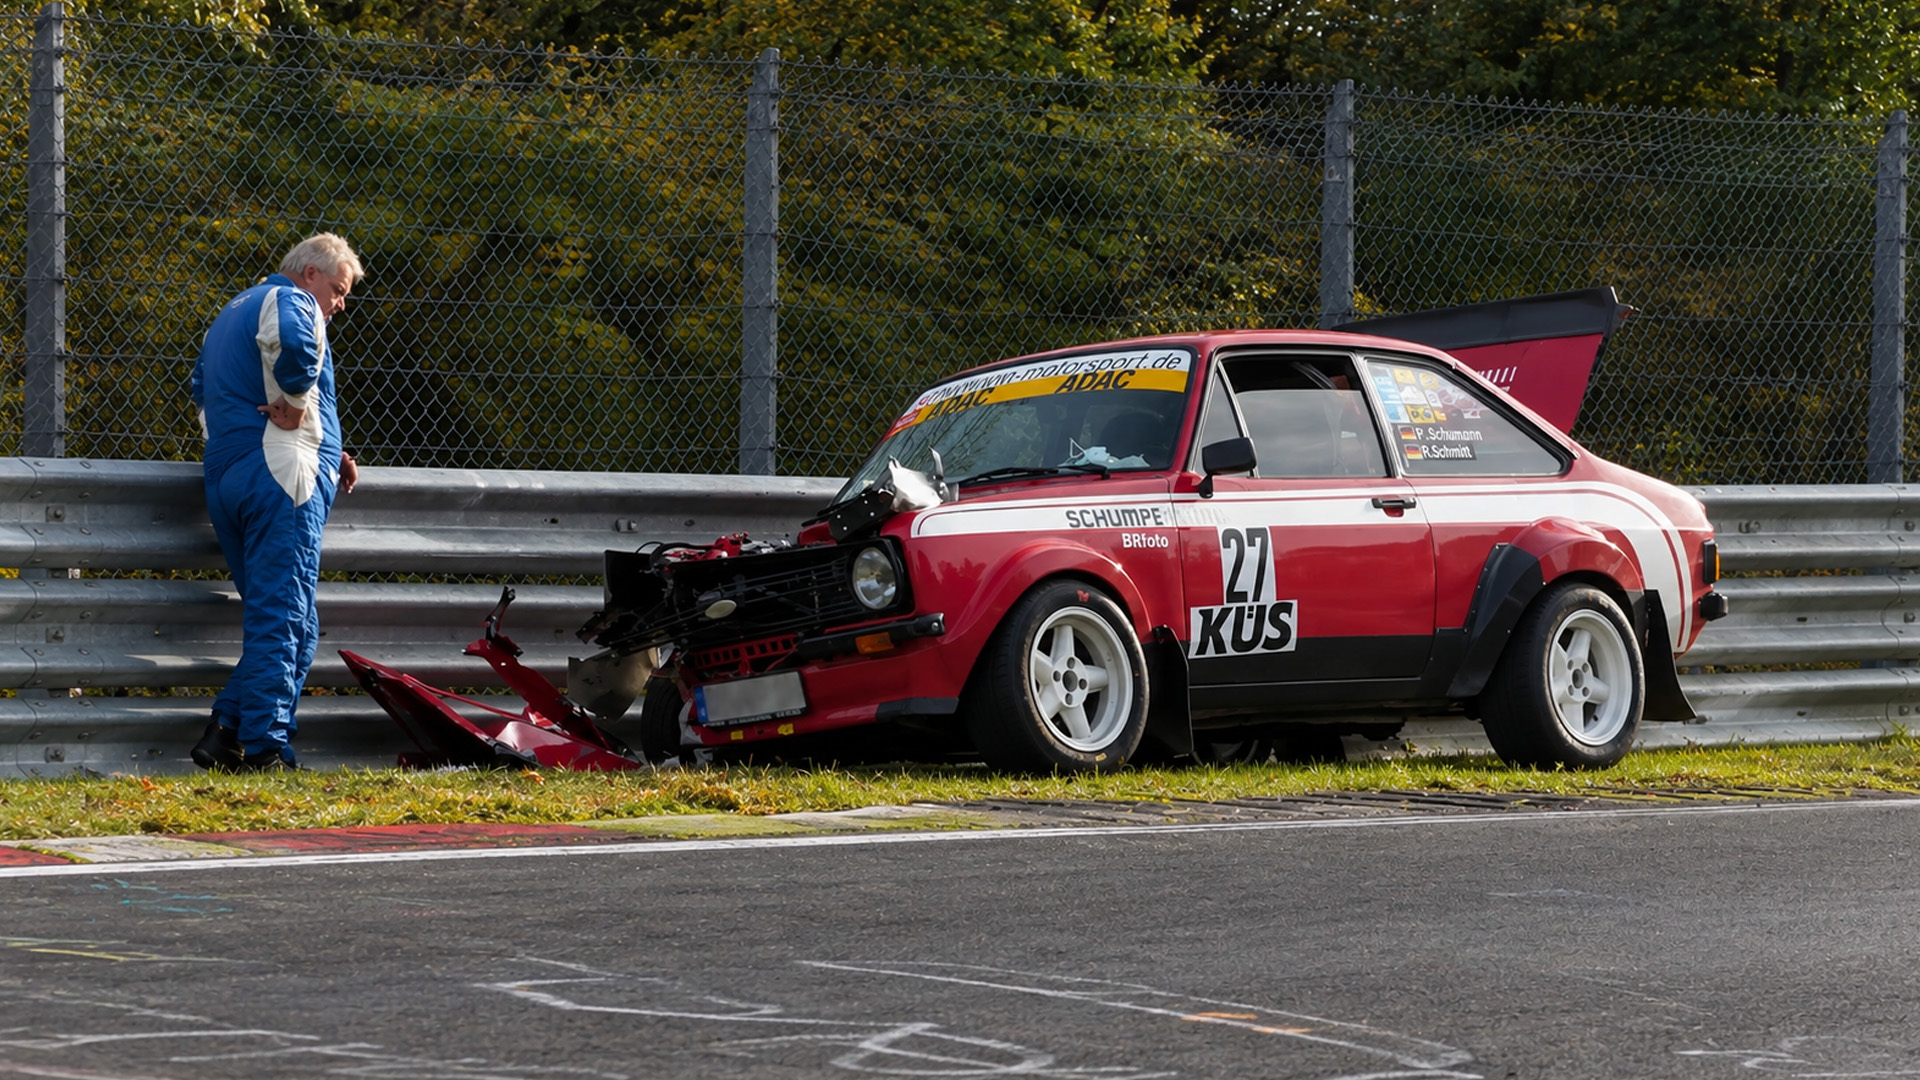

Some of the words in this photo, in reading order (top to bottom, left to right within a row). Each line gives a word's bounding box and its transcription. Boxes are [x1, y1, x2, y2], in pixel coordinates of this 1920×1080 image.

[924, 387, 995, 421] ADAC
[1054, 370, 1136, 394] ADAC
[1122, 533, 1169, 548] BRfoto
[1221, 527, 1269, 604] 27
[1195, 602, 1294, 656] KÜS
